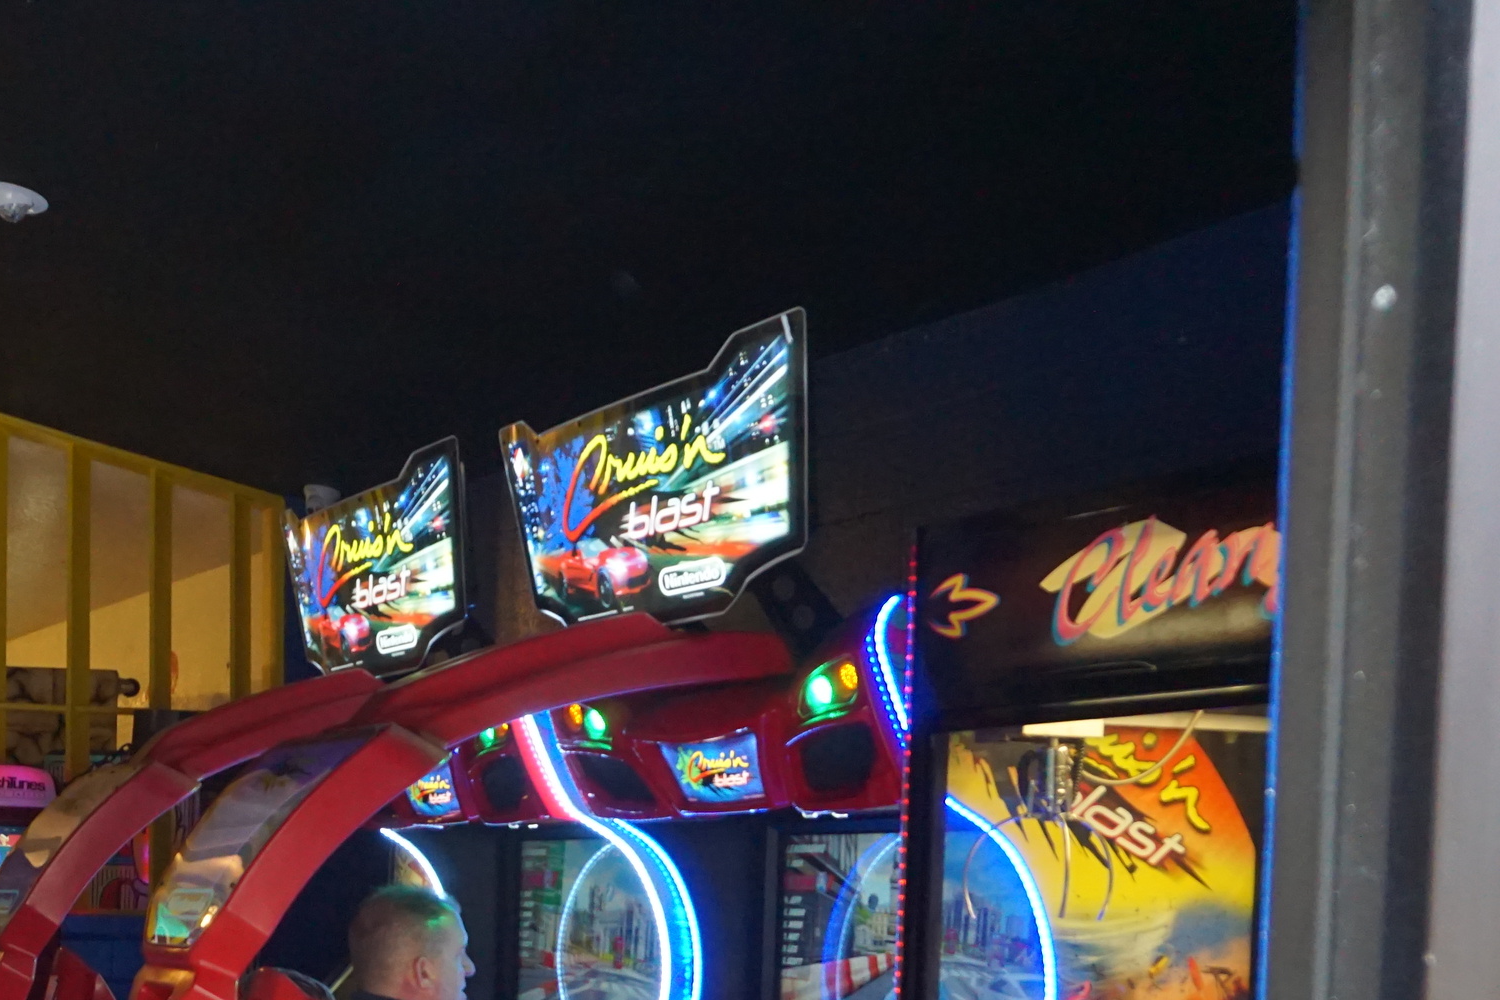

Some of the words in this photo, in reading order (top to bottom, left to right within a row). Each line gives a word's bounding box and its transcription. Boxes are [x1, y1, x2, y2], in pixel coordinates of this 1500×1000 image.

[562, 414, 726, 542] Cruis'n
[619, 480, 720, 540] blast
[350, 564, 411, 609] blast
[663, 566, 721, 591] Nintendo
